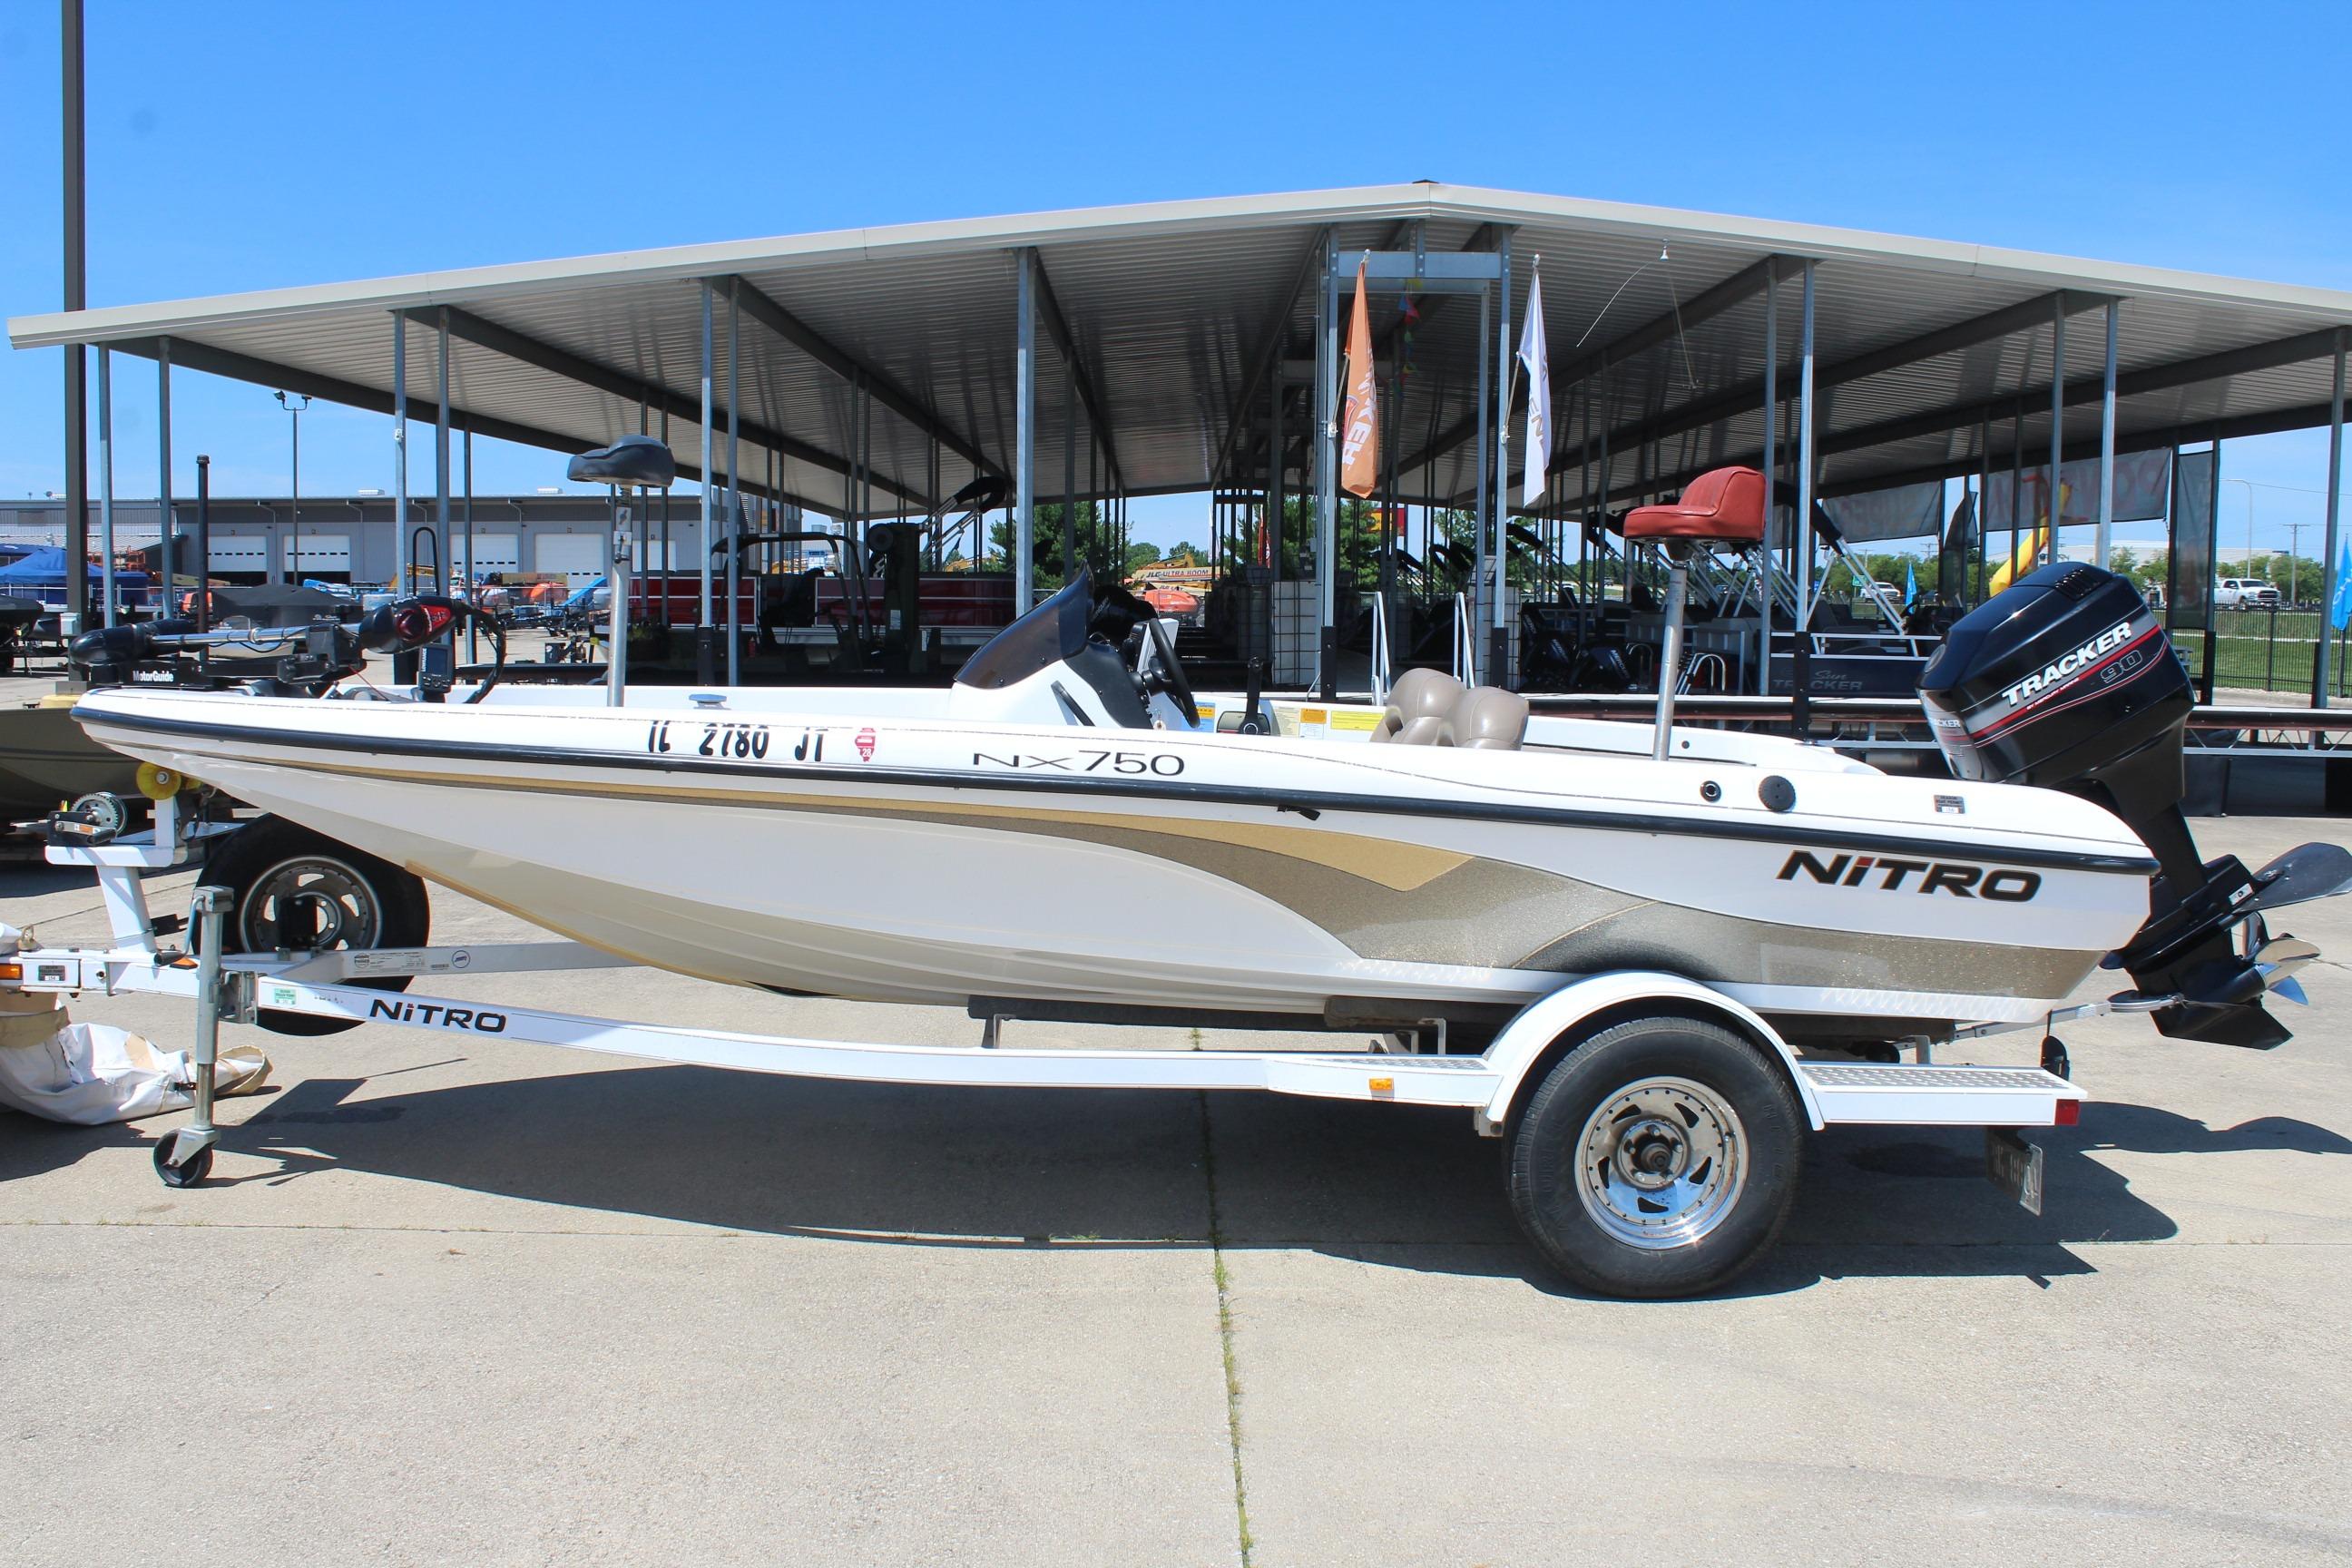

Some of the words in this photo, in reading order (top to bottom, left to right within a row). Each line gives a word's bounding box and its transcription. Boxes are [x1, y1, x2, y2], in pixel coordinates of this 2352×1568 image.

[2002, 622, 2132, 706] TRACKER
[2100, 650, 2142, 683] 90
[132, 670, 174, 682] MotorGuide
[1815, 670, 1847, 680] Sun
[1772, 680, 1863, 691] TRCKER
[648, 720, 671, 753] IL
[699, 723, 769, 760] 2780
[795, 727, 829, 762] JT
[862, 748, 872, 757] 28
